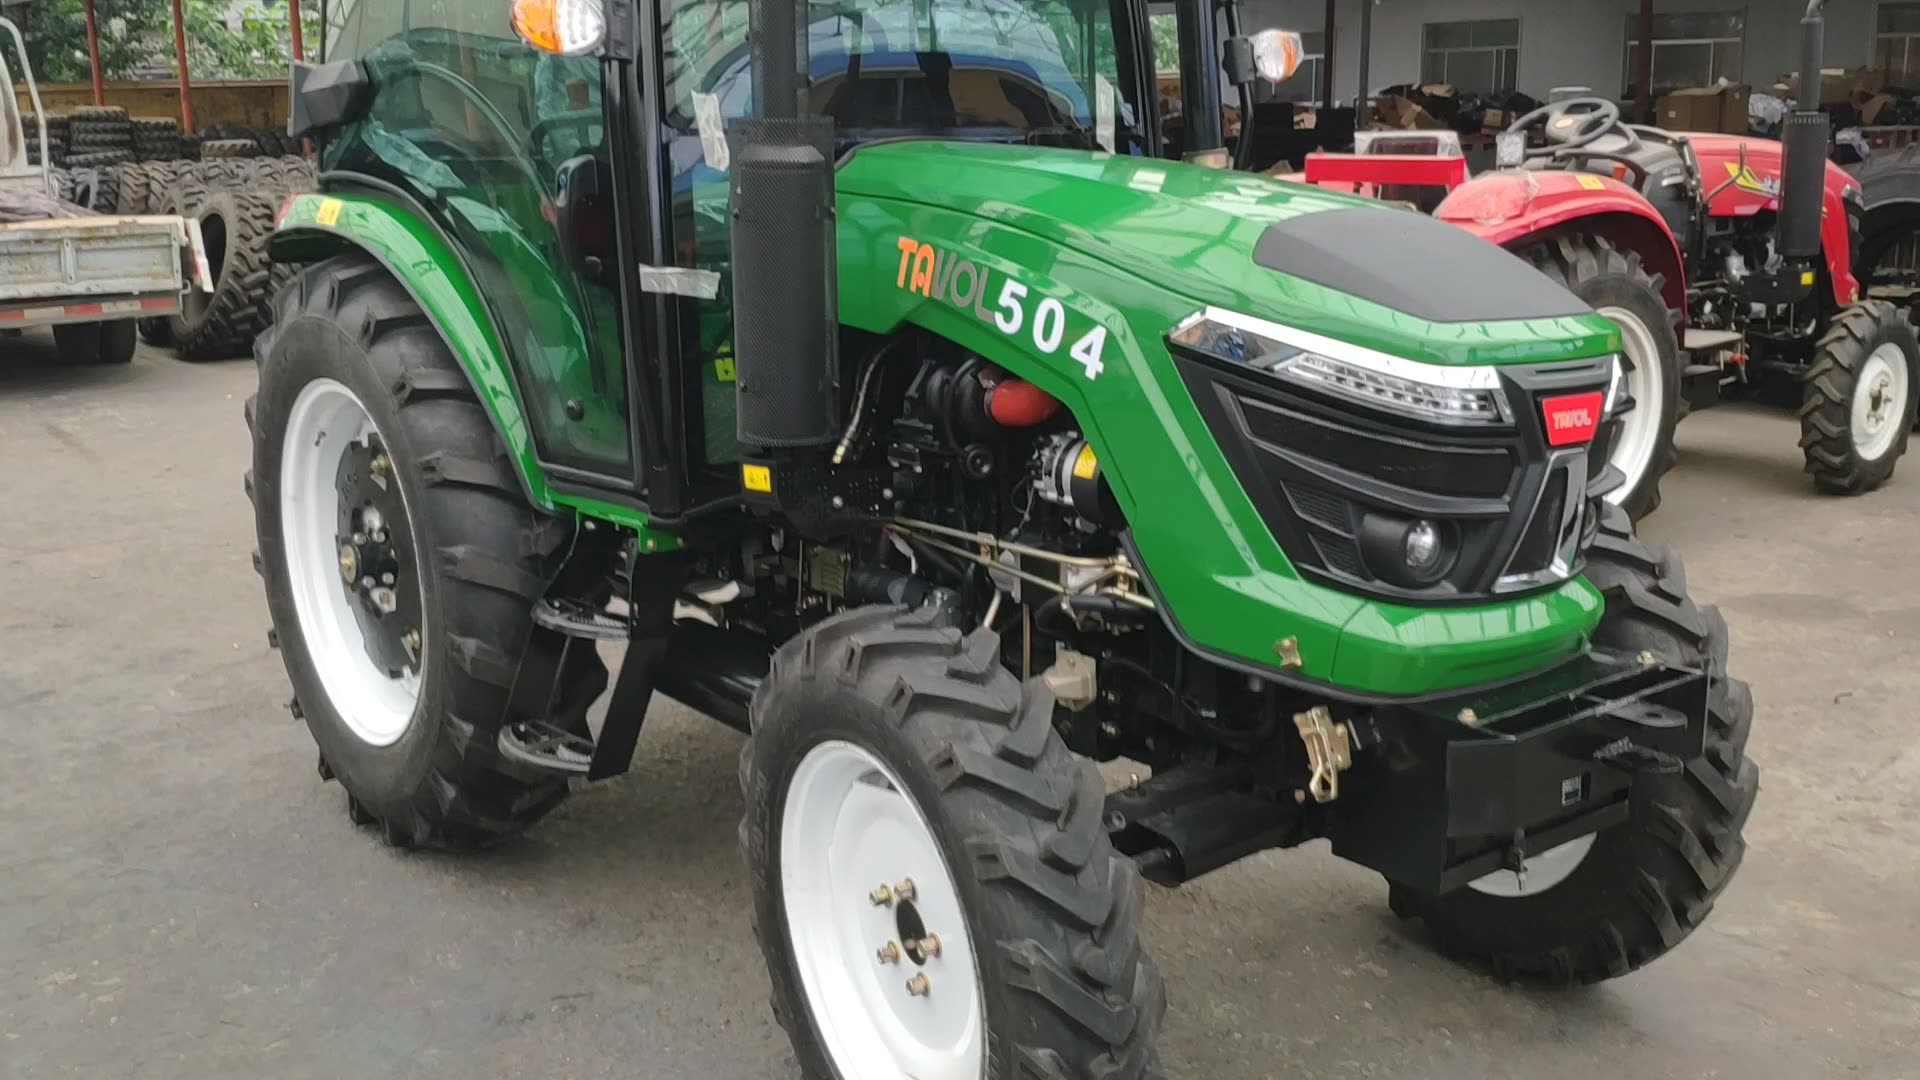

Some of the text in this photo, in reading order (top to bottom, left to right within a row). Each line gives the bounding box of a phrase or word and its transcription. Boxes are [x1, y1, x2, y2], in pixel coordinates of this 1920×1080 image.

[897, 236, 1107, 381] TAVOL 504
[1552, 408, 1592, 430] TAVOL
